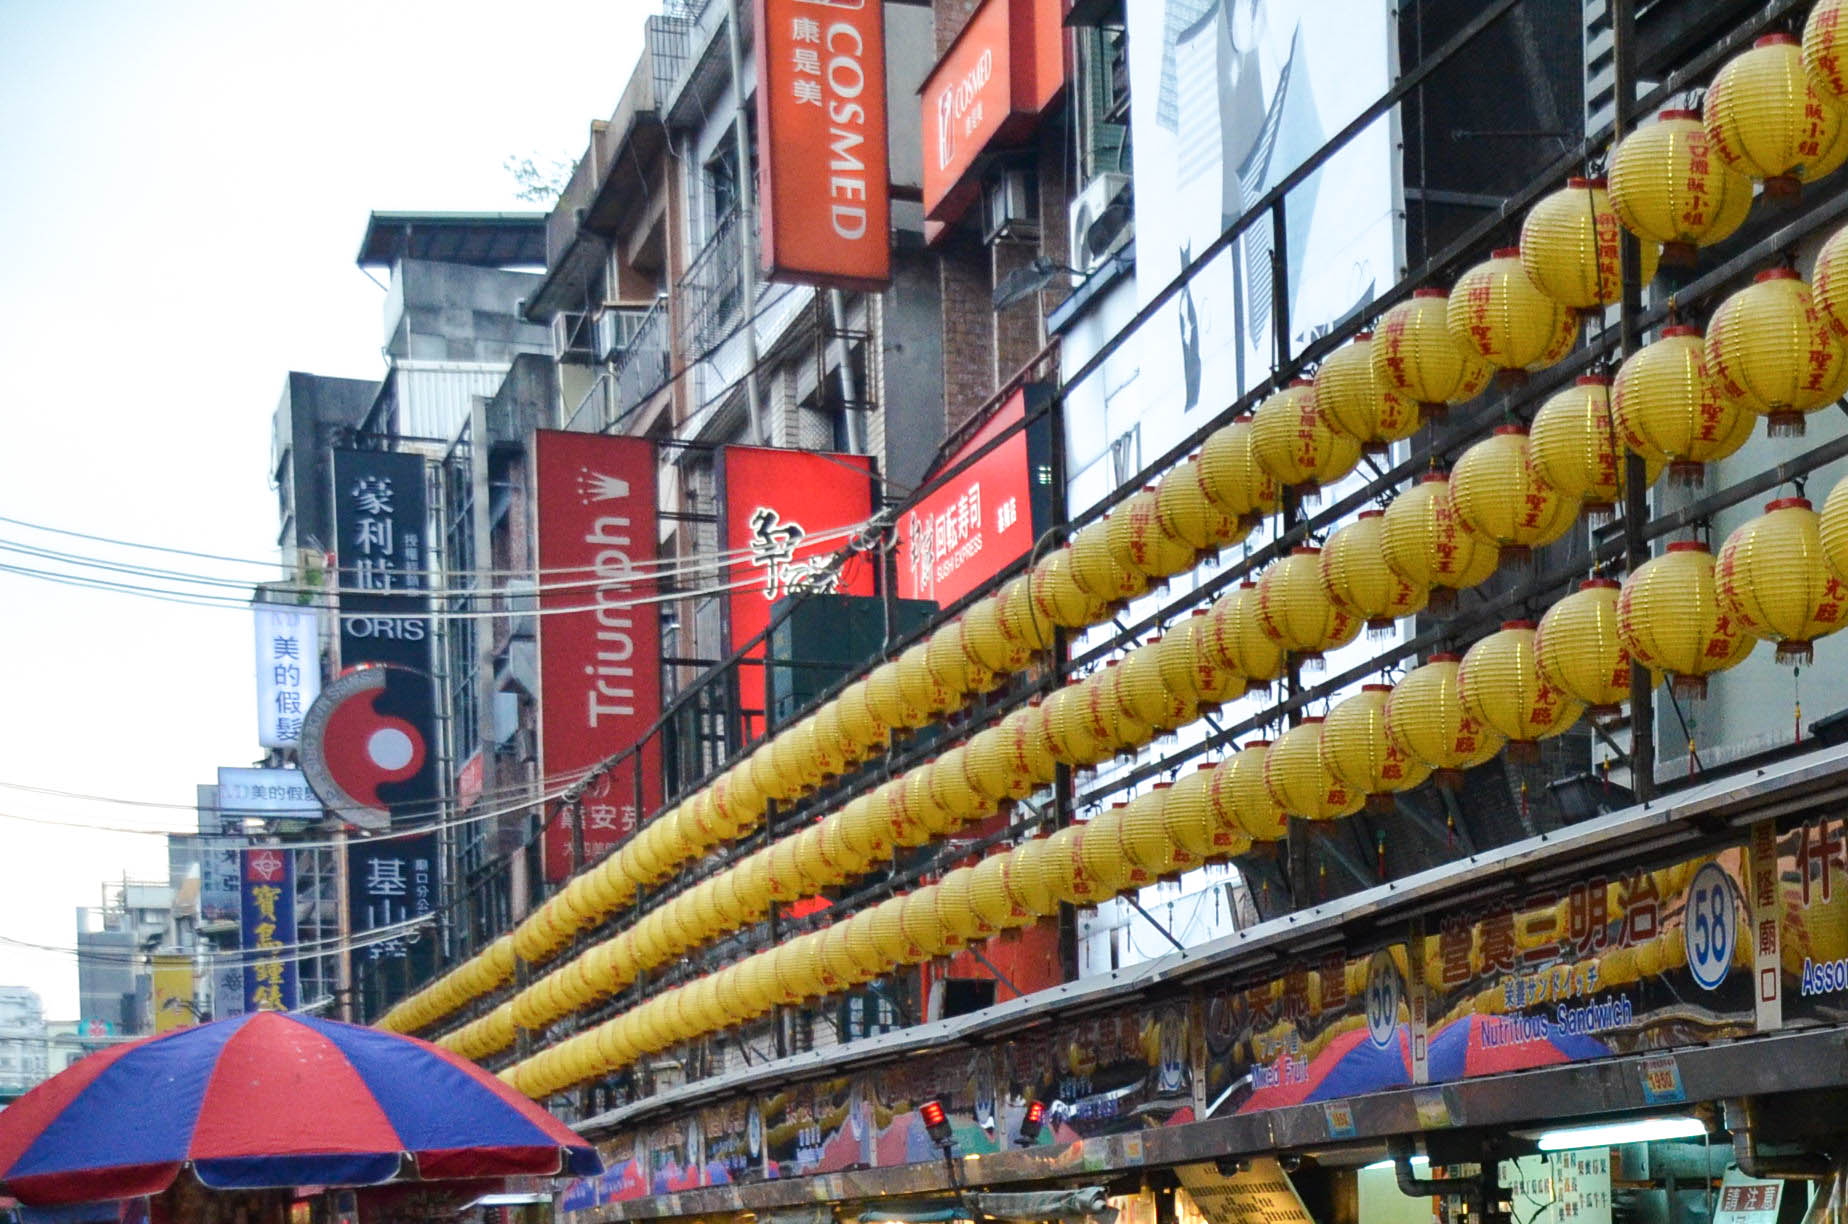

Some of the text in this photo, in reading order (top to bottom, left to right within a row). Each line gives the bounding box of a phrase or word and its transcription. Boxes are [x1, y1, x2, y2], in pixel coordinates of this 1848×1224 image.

[792, 17, 822, 107] 康是美
[954, 48, 992, 120] COSMED
[827, 23, 866, 240] COSMED
[955, 533, 984, 572] EXPRESS
[345, 617, 425, 641] ORIS
[583, 513, 636, 727] Triumph
[273, 635, 302, 743] 美的假髮
[1694, 882, 1728, 966] 58
[1371, 966, 1394, 1023] 56
[1480, 993, 1633, 1050] Nutritious Sandwich
[1649, 1071, 1674, 1091] 1950
